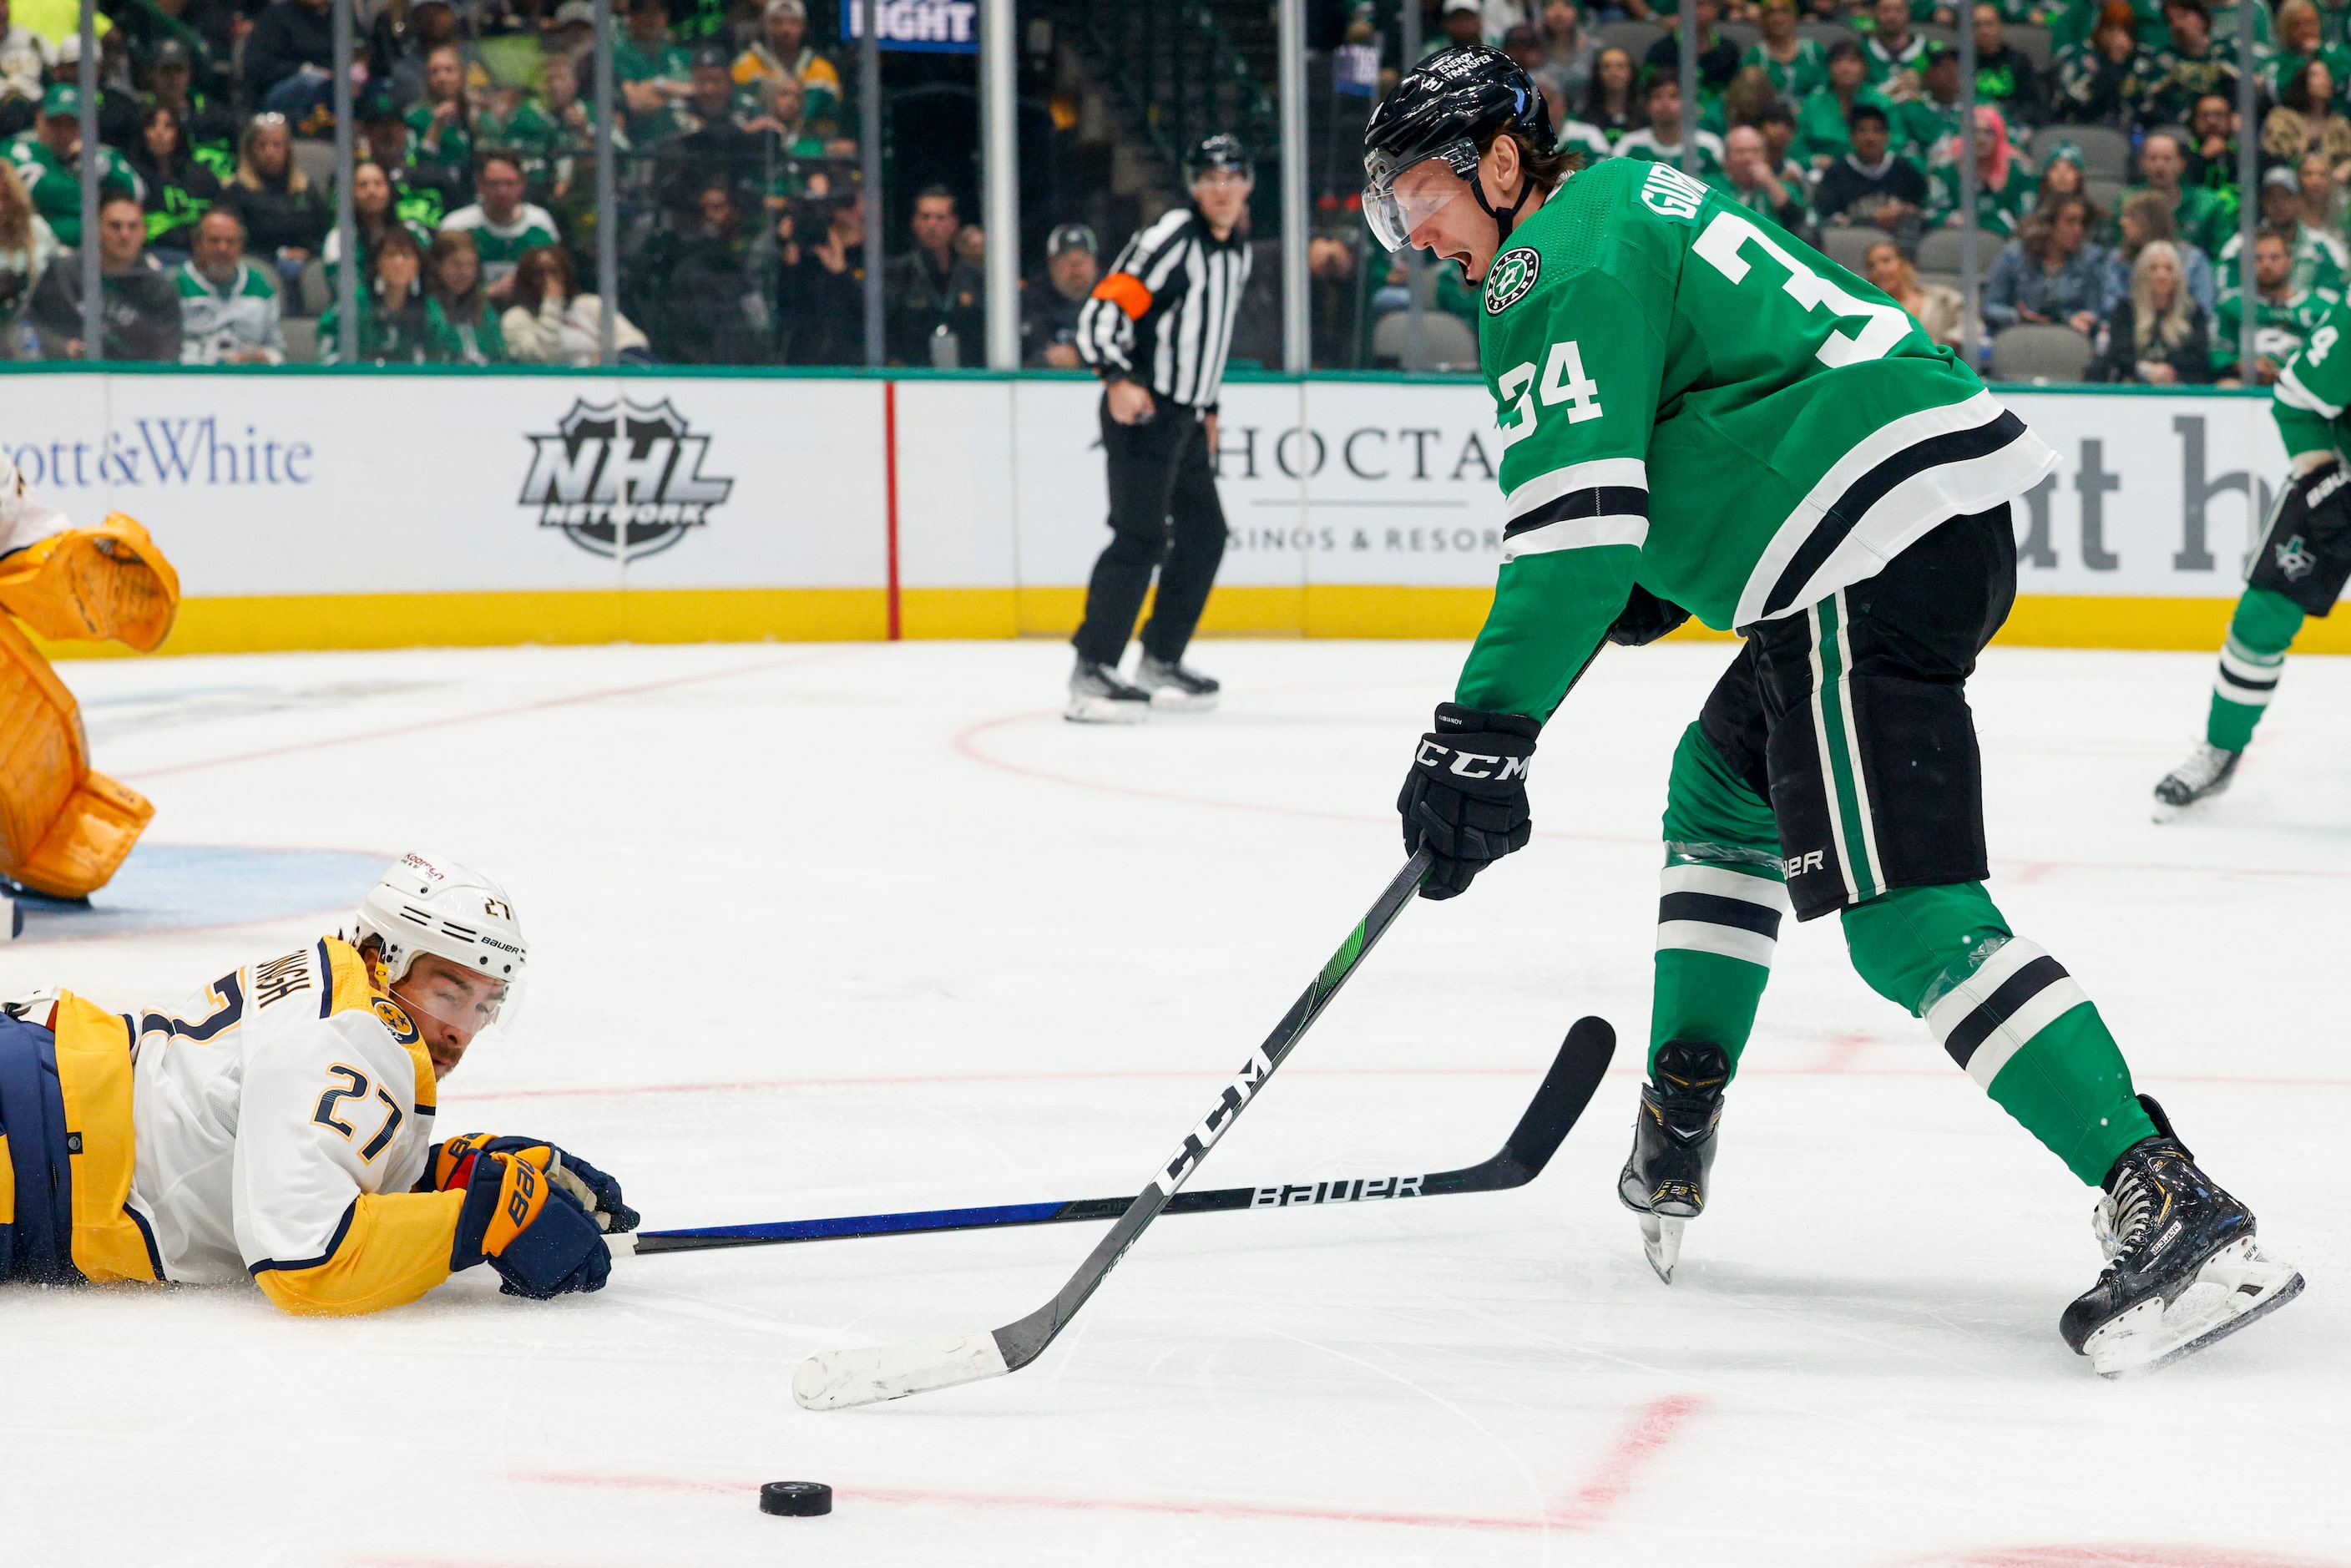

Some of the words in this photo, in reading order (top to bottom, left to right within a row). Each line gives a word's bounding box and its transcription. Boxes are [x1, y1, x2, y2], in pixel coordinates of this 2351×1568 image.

[1445, 54, 1494, 81] TRANSFER
[1487, 251, 1532, 299] DALLAS
[1493, 268, 1534, 310] STARS
[1498, 339, 1603, 451] 34
[519, 432, 735, 505] NHL
[1214, 427, 1499, 482] HOCTA
[1228, 529, 1336, 552] SINOS
[1386, 529, 1502, 552] RESOR
[1416, 739, 1532, 781] CCM
[480, 936, 520, 955] BAUER
[310, 1062, 405, 1166] 27
[1154, 1047, 1272, 1196] CCM
[1249, 1173, 1425, 1208] BAUER
